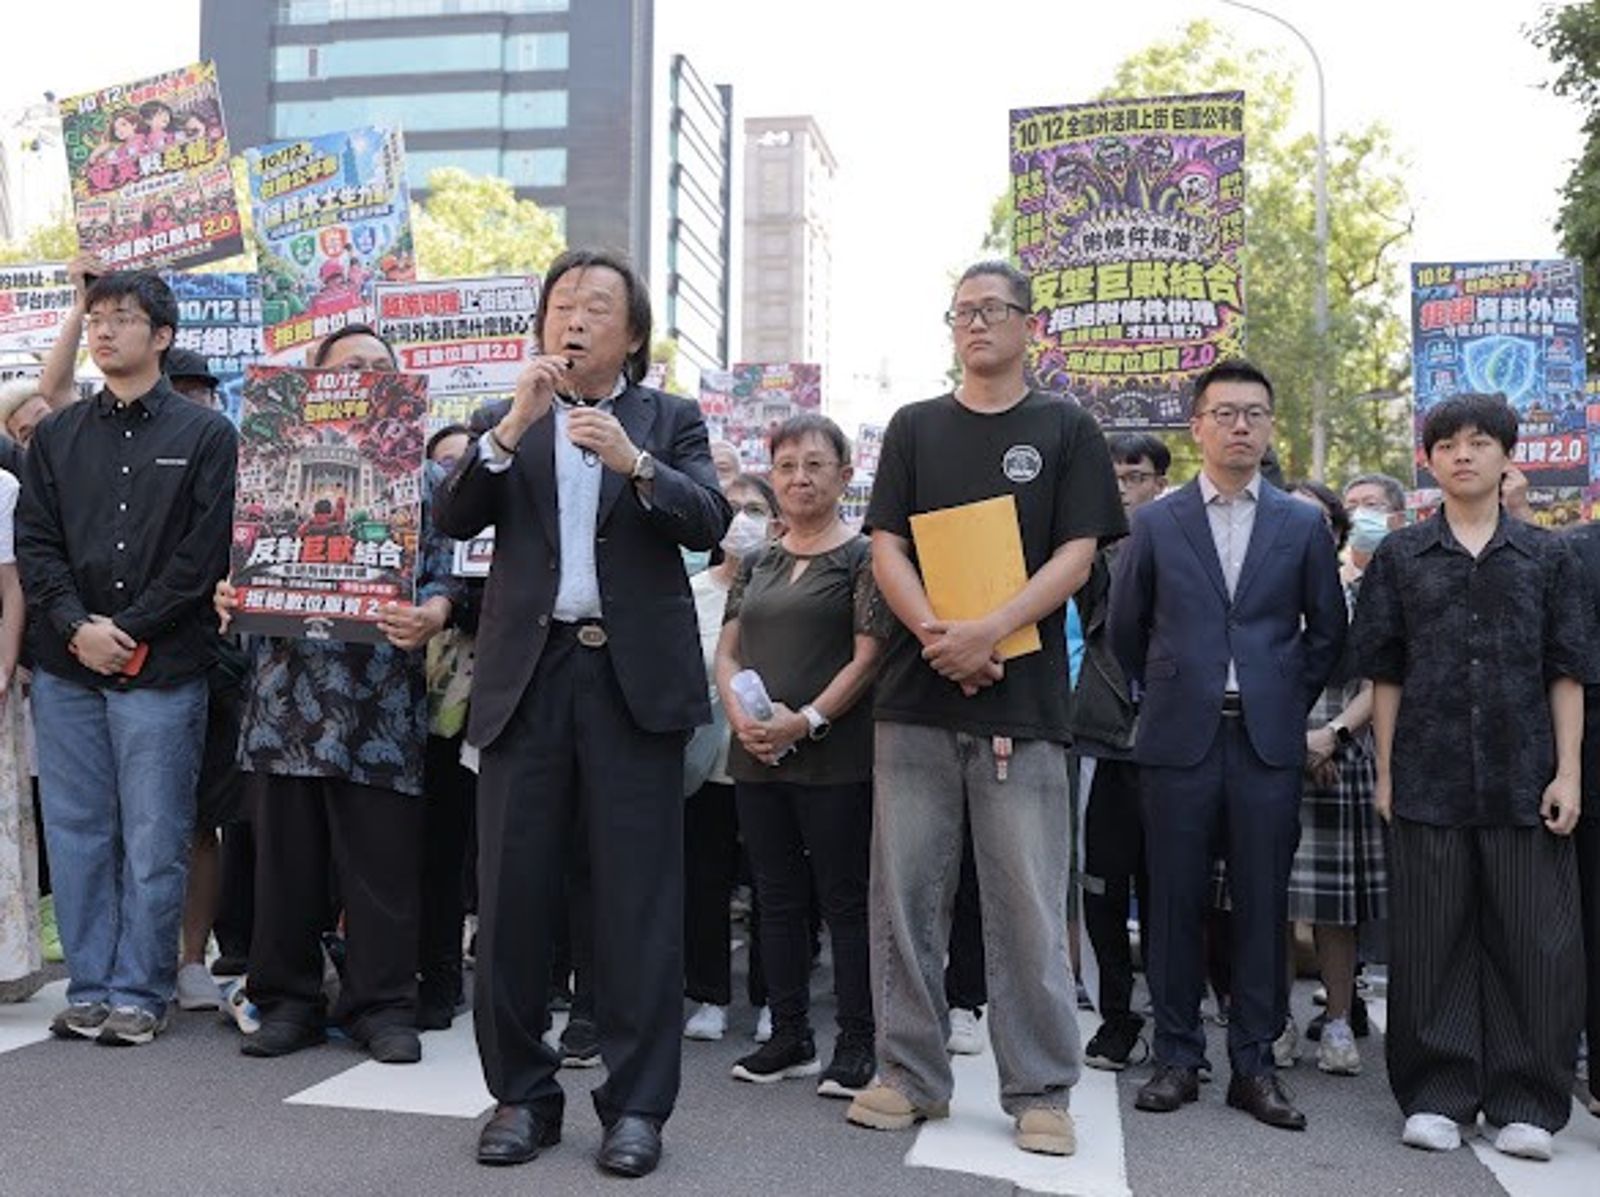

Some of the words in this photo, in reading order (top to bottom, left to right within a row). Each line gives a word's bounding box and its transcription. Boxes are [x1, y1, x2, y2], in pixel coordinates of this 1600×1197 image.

[178, 300, 235, 320] 10/12
[315, 373, 361, 389] 10/12
[247, 534, 404, 569] 反對巨獸結合
